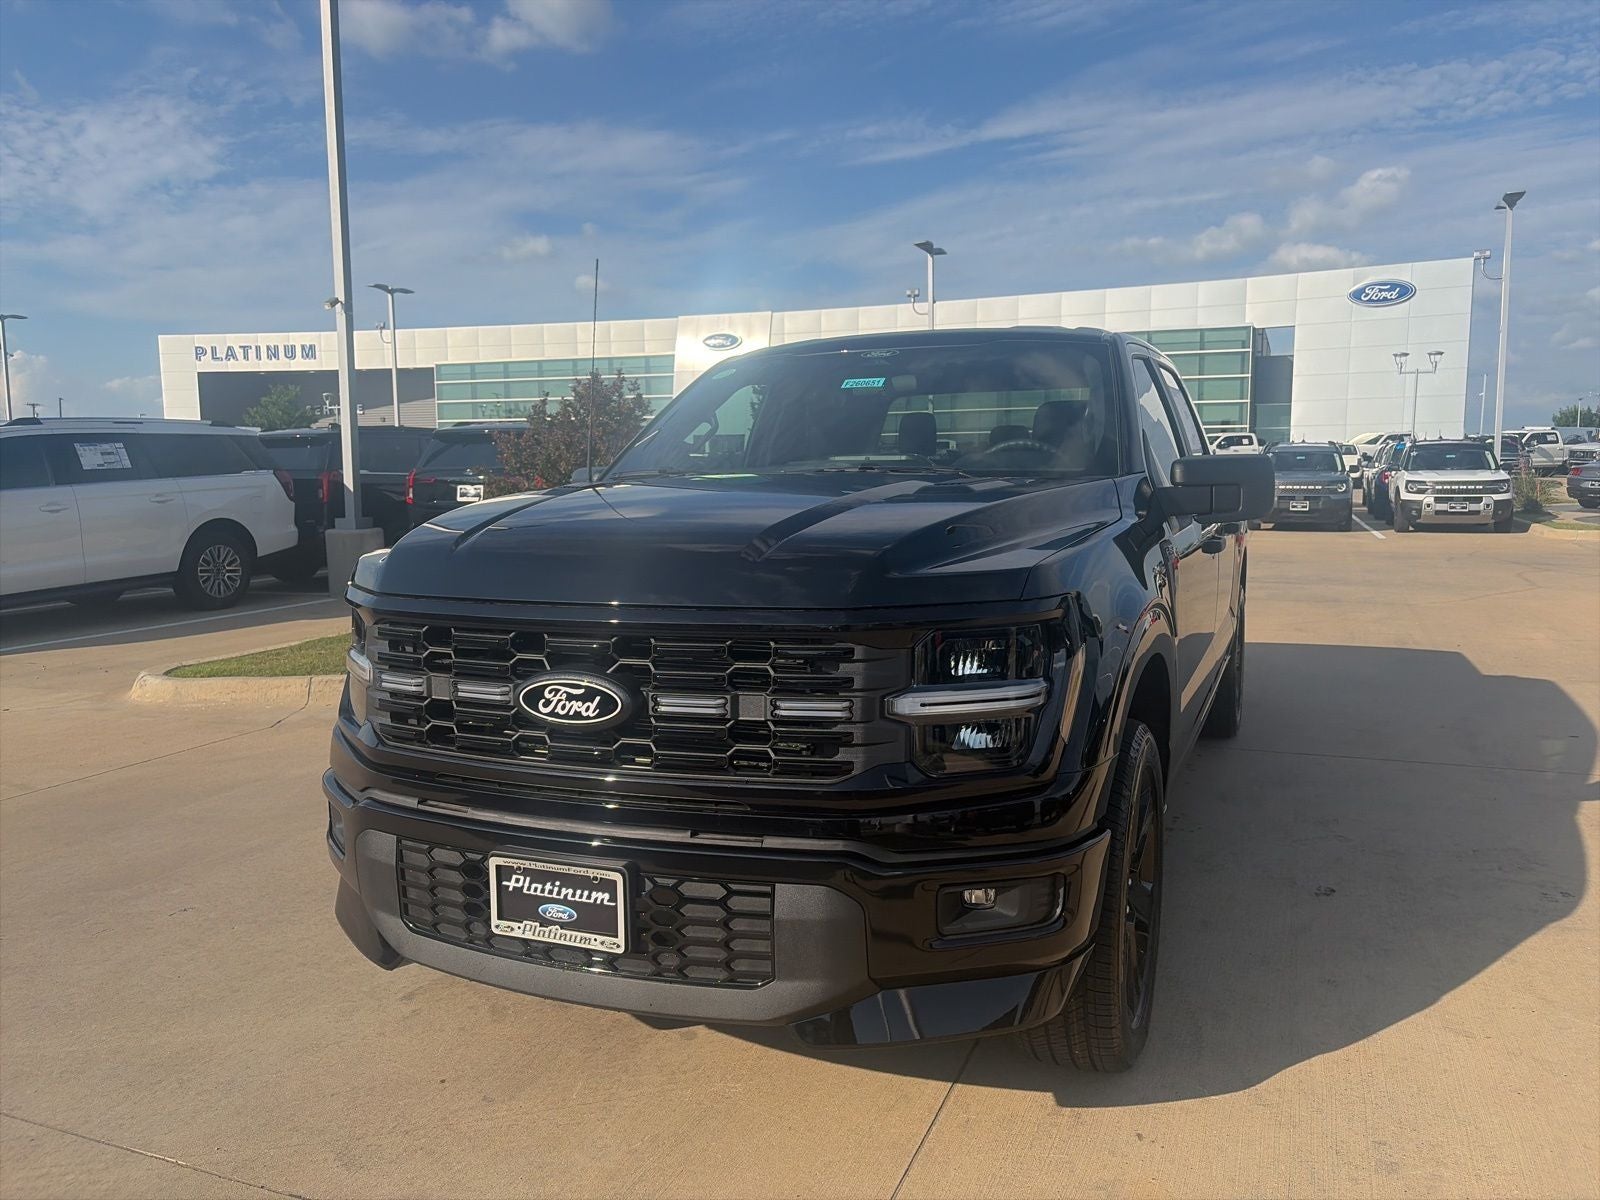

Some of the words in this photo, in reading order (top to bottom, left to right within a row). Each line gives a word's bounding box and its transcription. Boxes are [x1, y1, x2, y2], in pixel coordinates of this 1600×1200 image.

[361, 285, 401, 301] Ford
[194, 343, 317, 361] PLATINUM
[538, 685, 601, 717] Ford
[501, 874, 617, 906] Platinum
[545, 905, 569, 920] Ford
[521, 921, 598, 947] Platinum
